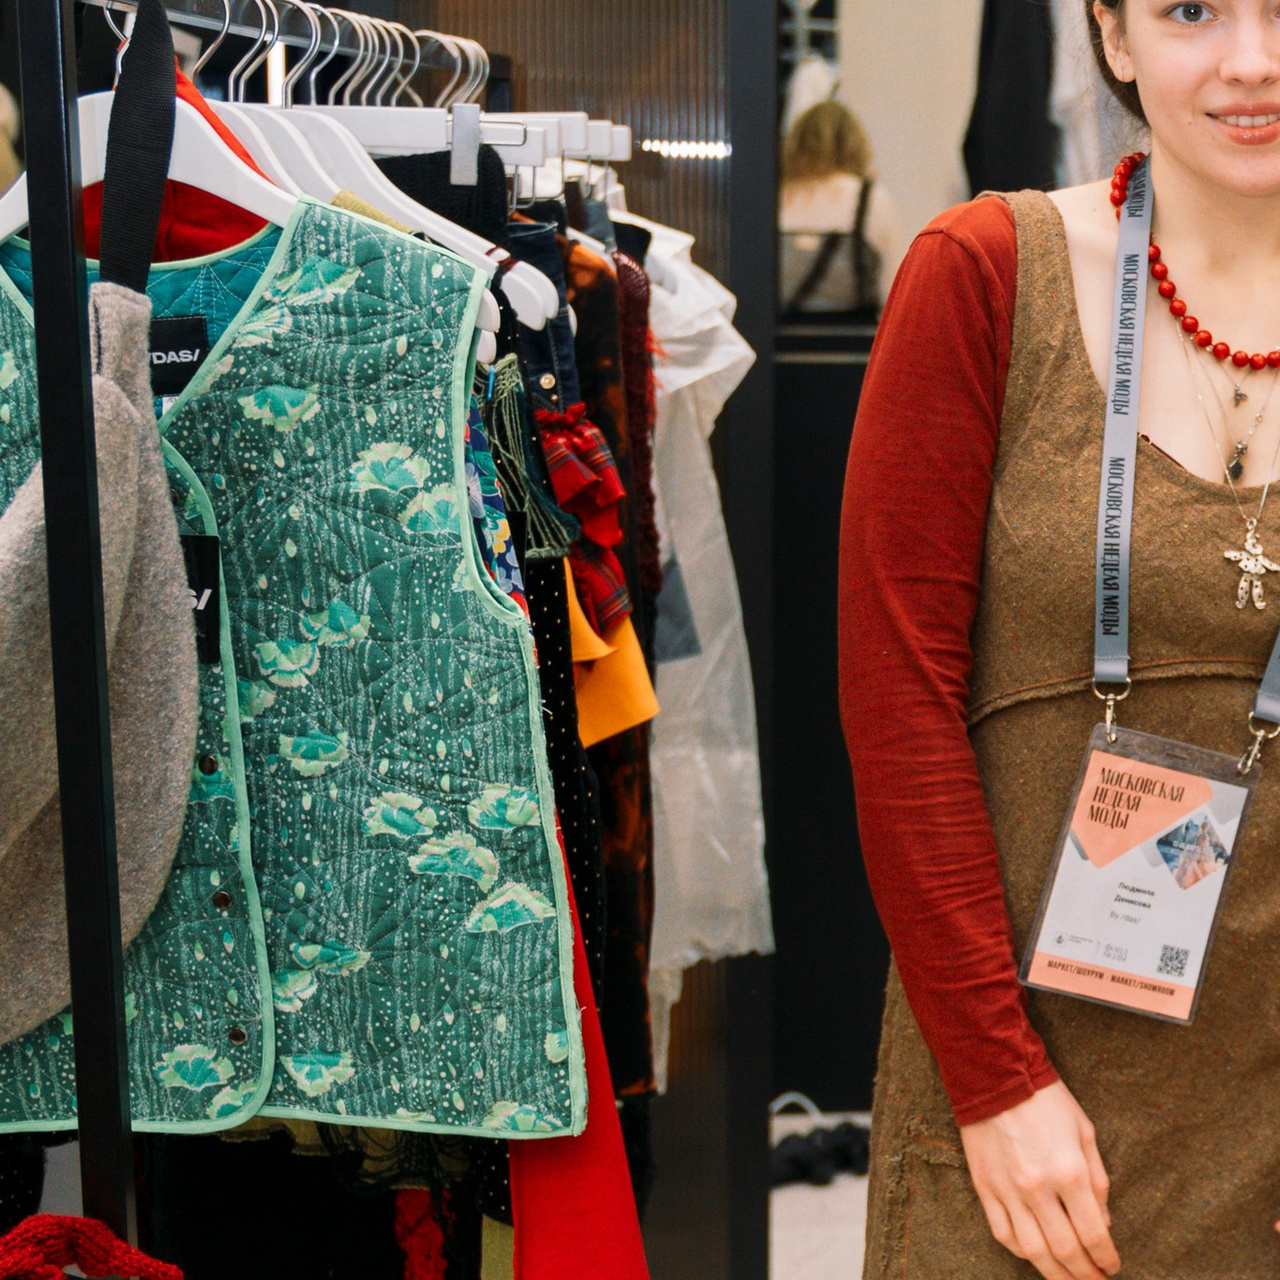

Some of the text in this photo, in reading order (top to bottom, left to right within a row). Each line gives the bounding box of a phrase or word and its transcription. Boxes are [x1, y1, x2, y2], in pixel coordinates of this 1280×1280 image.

[1112, 253, 1140, 416] МОСКОВСКАЯ НЕДЕЛЯ МОДЫ
[1100, 455, 1125, 636] МОСКОВСКАЯ НЕДЕЛЯ МОДЫ
[1092, 786, 1142, 812] НЕДЕЛЯ
[1100, 767, 1185, 803] МОСКОВСКАЯ
[1088, 804, 1130, 829] МОДЫ
